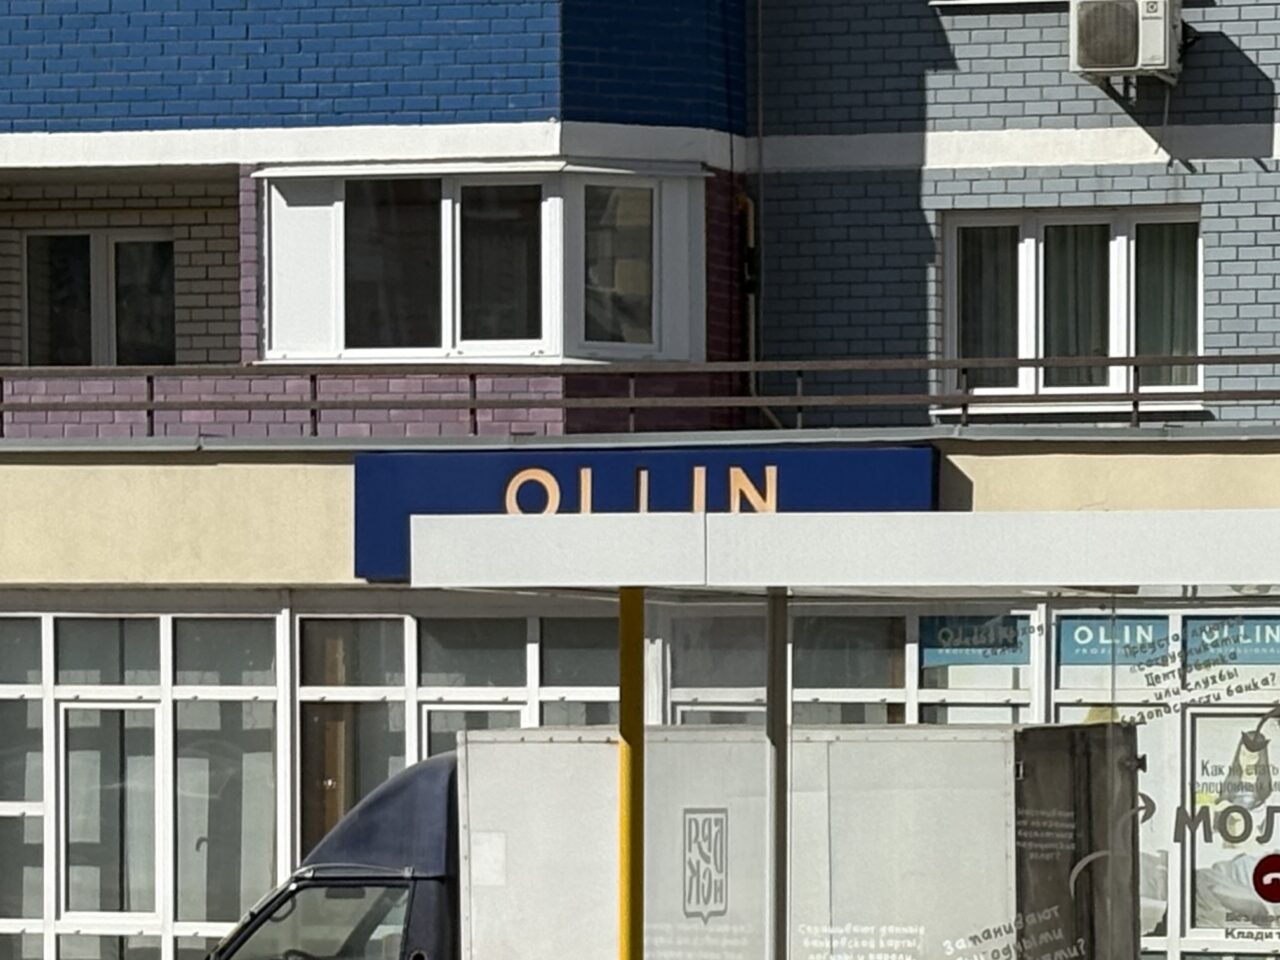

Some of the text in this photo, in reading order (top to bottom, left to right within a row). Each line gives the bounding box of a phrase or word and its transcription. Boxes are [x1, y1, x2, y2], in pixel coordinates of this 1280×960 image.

[1154, 668, 1239, 702] или службы
[1226, 672, 1277, 697] банка?
[1201, 760, 1225, 776] Как
[1225, 928, 1273, 941] Клади
